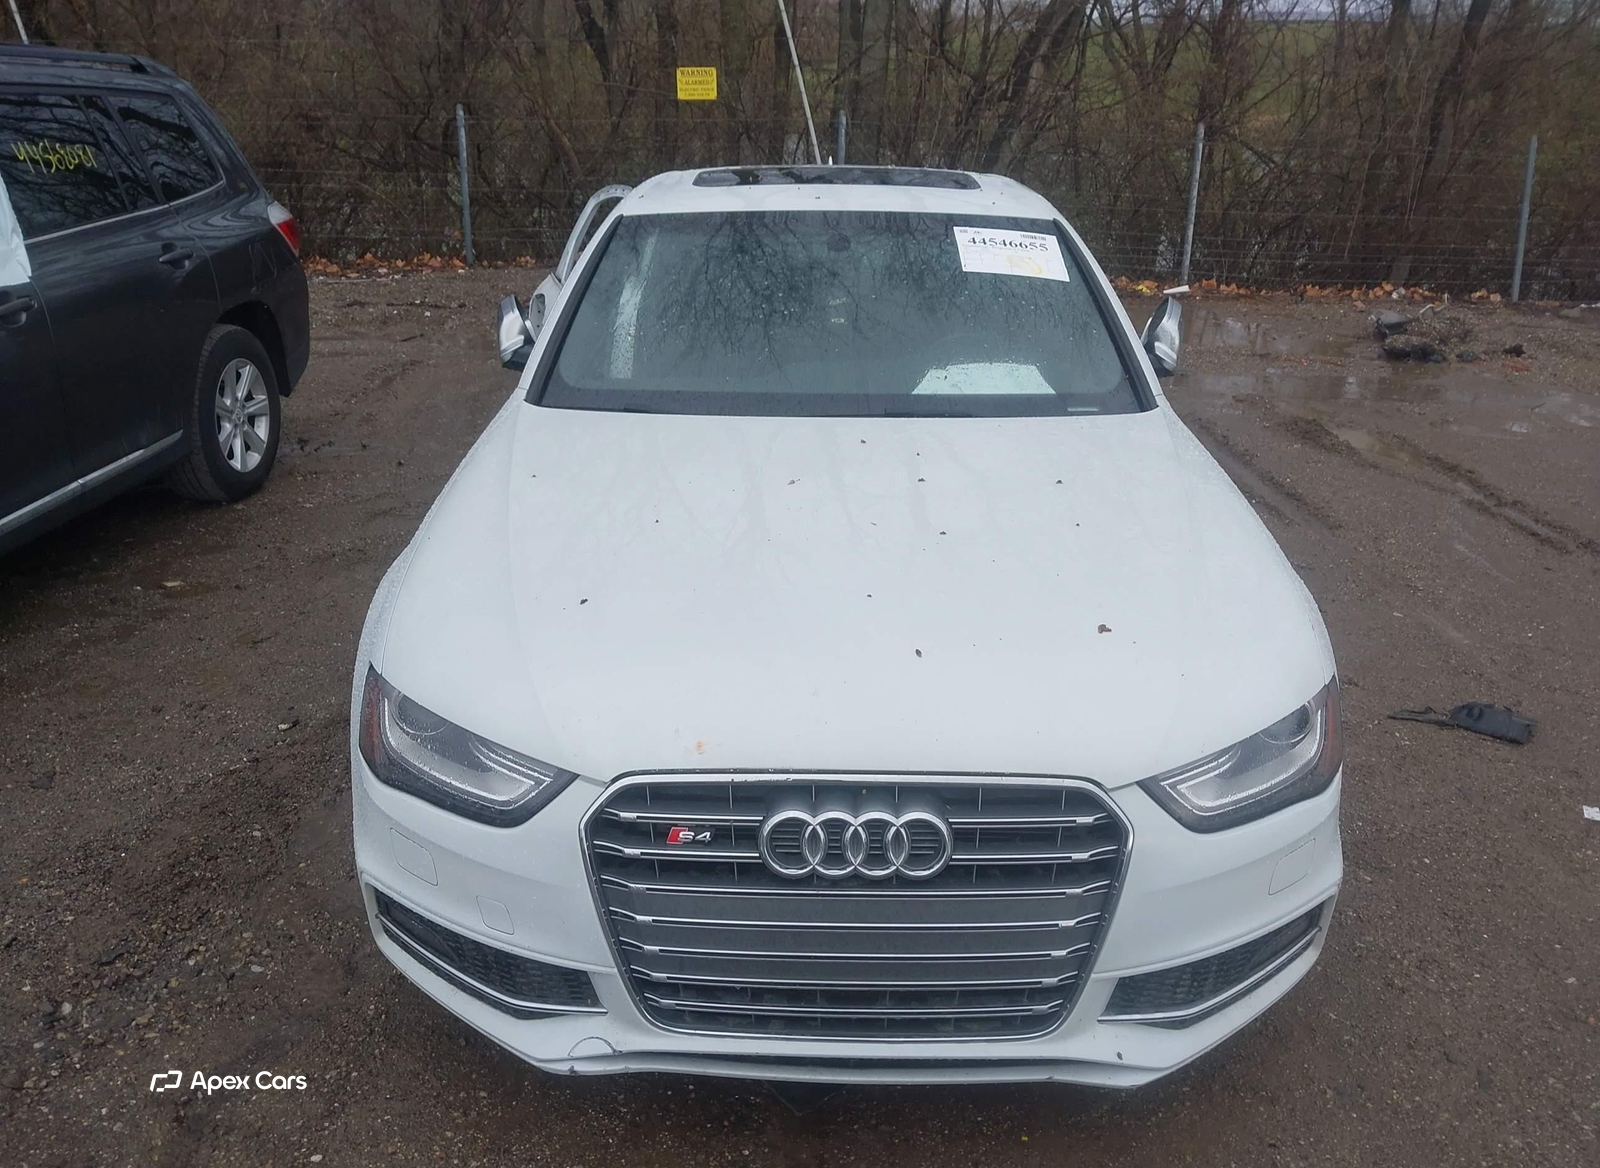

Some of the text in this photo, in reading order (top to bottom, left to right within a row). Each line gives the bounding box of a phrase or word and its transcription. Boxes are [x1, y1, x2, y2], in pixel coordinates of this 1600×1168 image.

[11, 139, 98, 174] 44568081
[967, 236, 1049, 252] 44546655
[677, 830, 711, 843] S4
